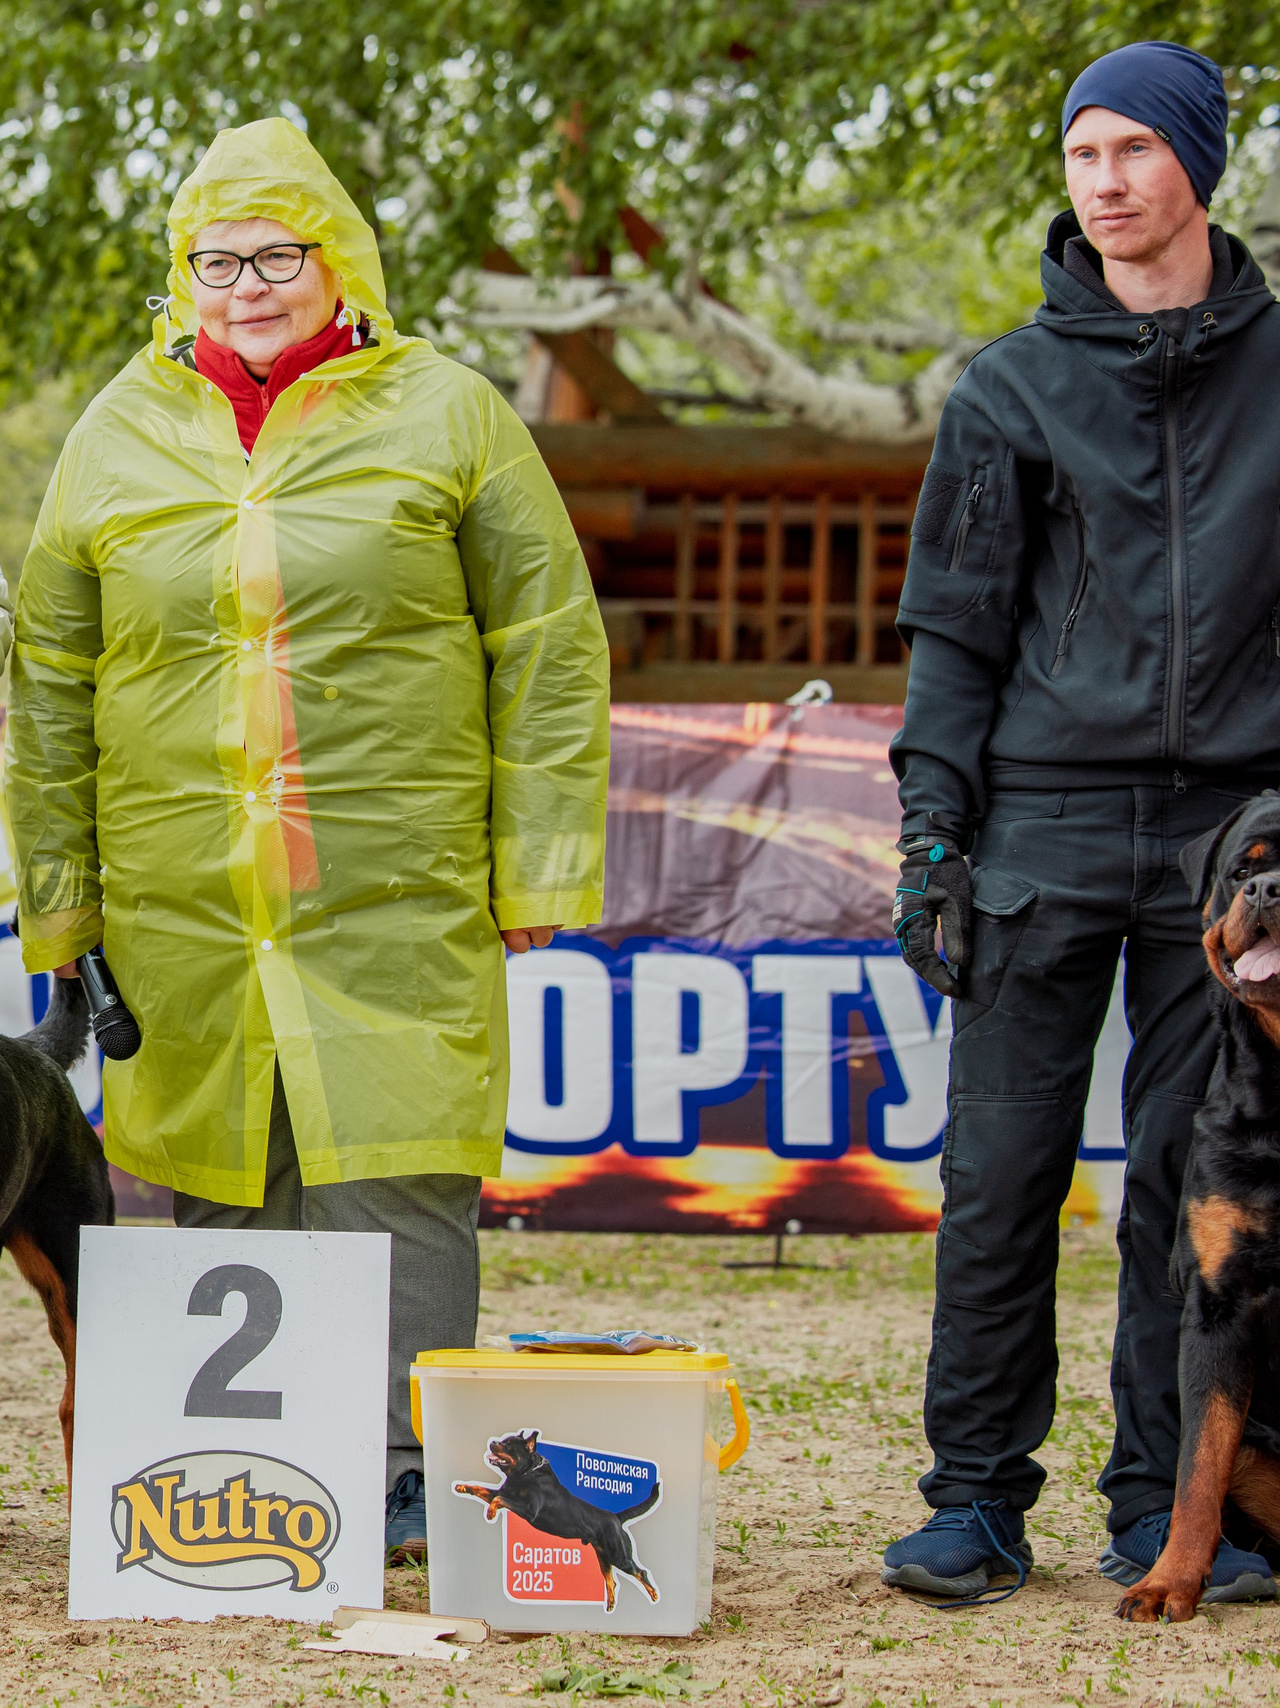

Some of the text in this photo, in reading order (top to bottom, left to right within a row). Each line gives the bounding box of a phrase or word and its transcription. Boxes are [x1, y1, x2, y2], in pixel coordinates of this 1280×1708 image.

[502, 947, 1128, 1151] ОРТУ
[182, 1263, 283, 1420] 2
[576, 1452, 649, 1480] Поволжская
[576, 1470, 633, 1495] Рапсодия
[112, 1469, 331, 1592] Nutro
[512, 1541, 582, 1570] Саратов
[512, 1570, 554, 1593] 2025
